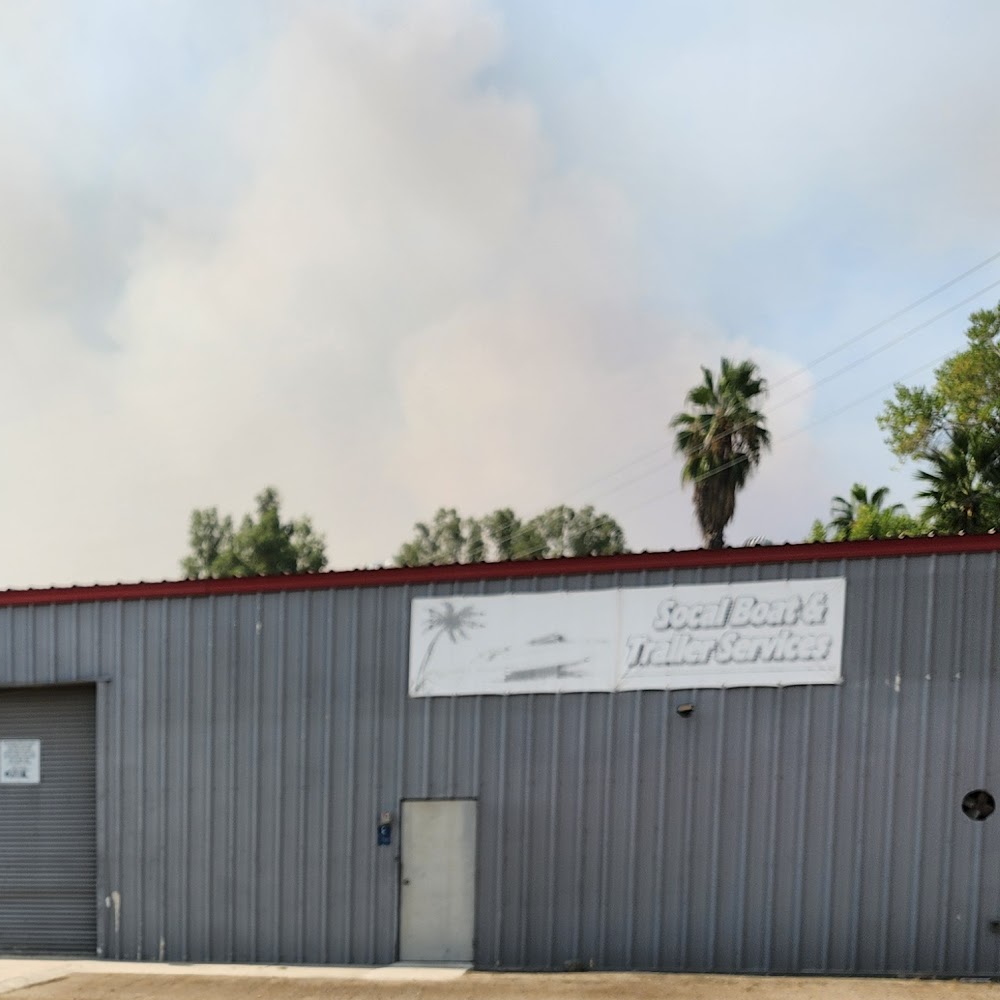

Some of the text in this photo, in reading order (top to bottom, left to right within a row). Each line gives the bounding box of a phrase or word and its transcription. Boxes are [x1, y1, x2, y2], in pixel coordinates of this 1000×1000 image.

[652, 590, 829, 631] Socal Boat &
[627, 628, 833, 668] Trailer Services
